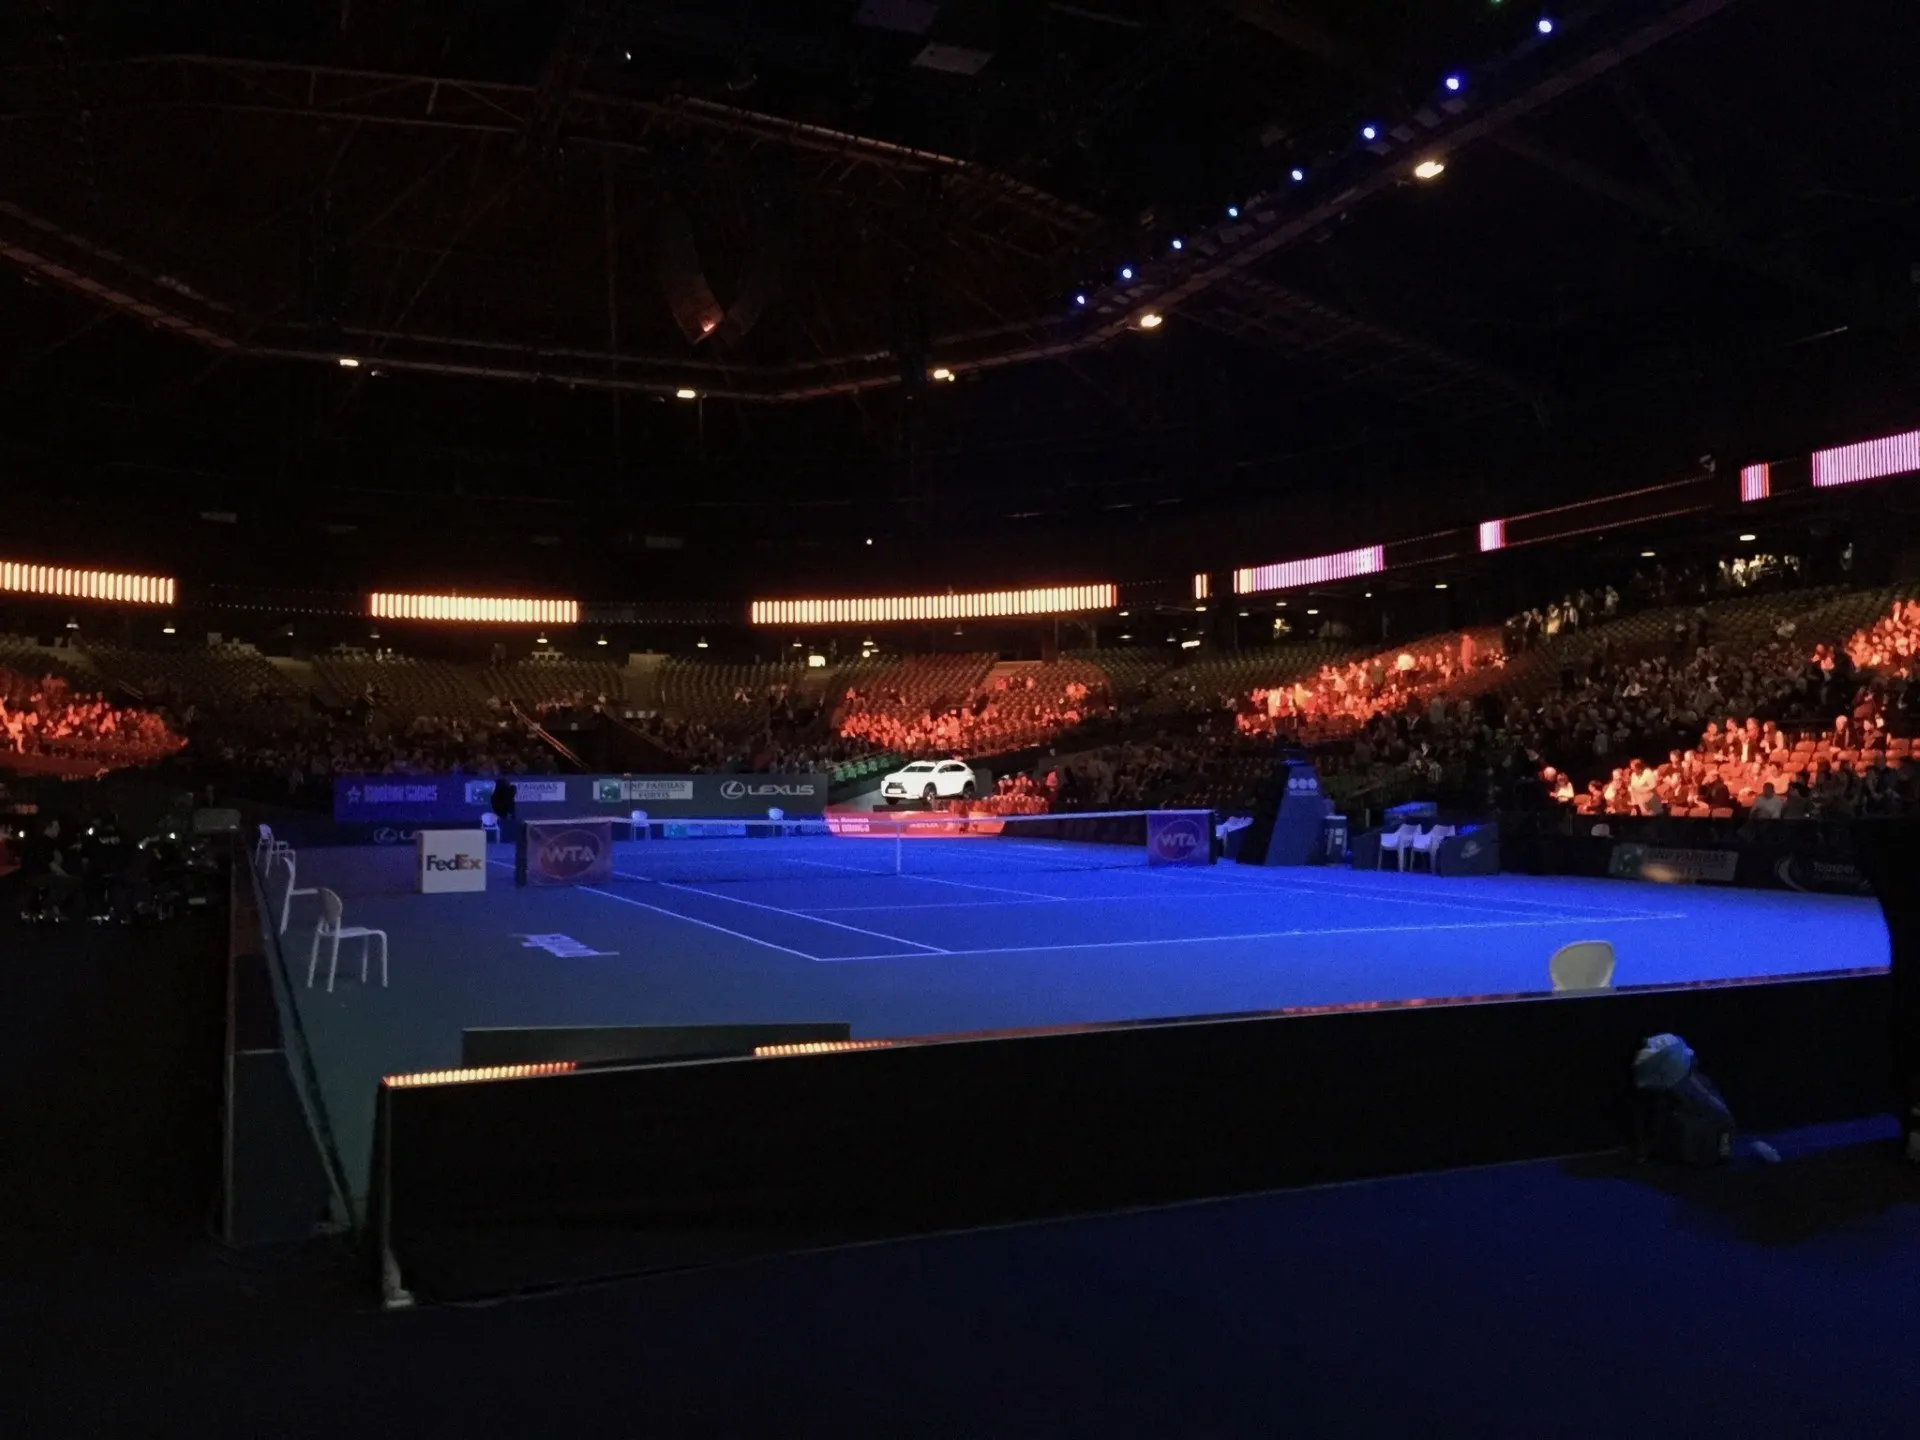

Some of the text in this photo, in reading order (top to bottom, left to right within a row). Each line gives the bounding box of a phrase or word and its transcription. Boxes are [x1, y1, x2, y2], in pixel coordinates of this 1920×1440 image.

[748, 785, 815, 795] LEXUS
[1160, 833, 1198, 847] WTA
[540, 846, 595, 862] WTA
[427, 854, 481, 871] FedEx
